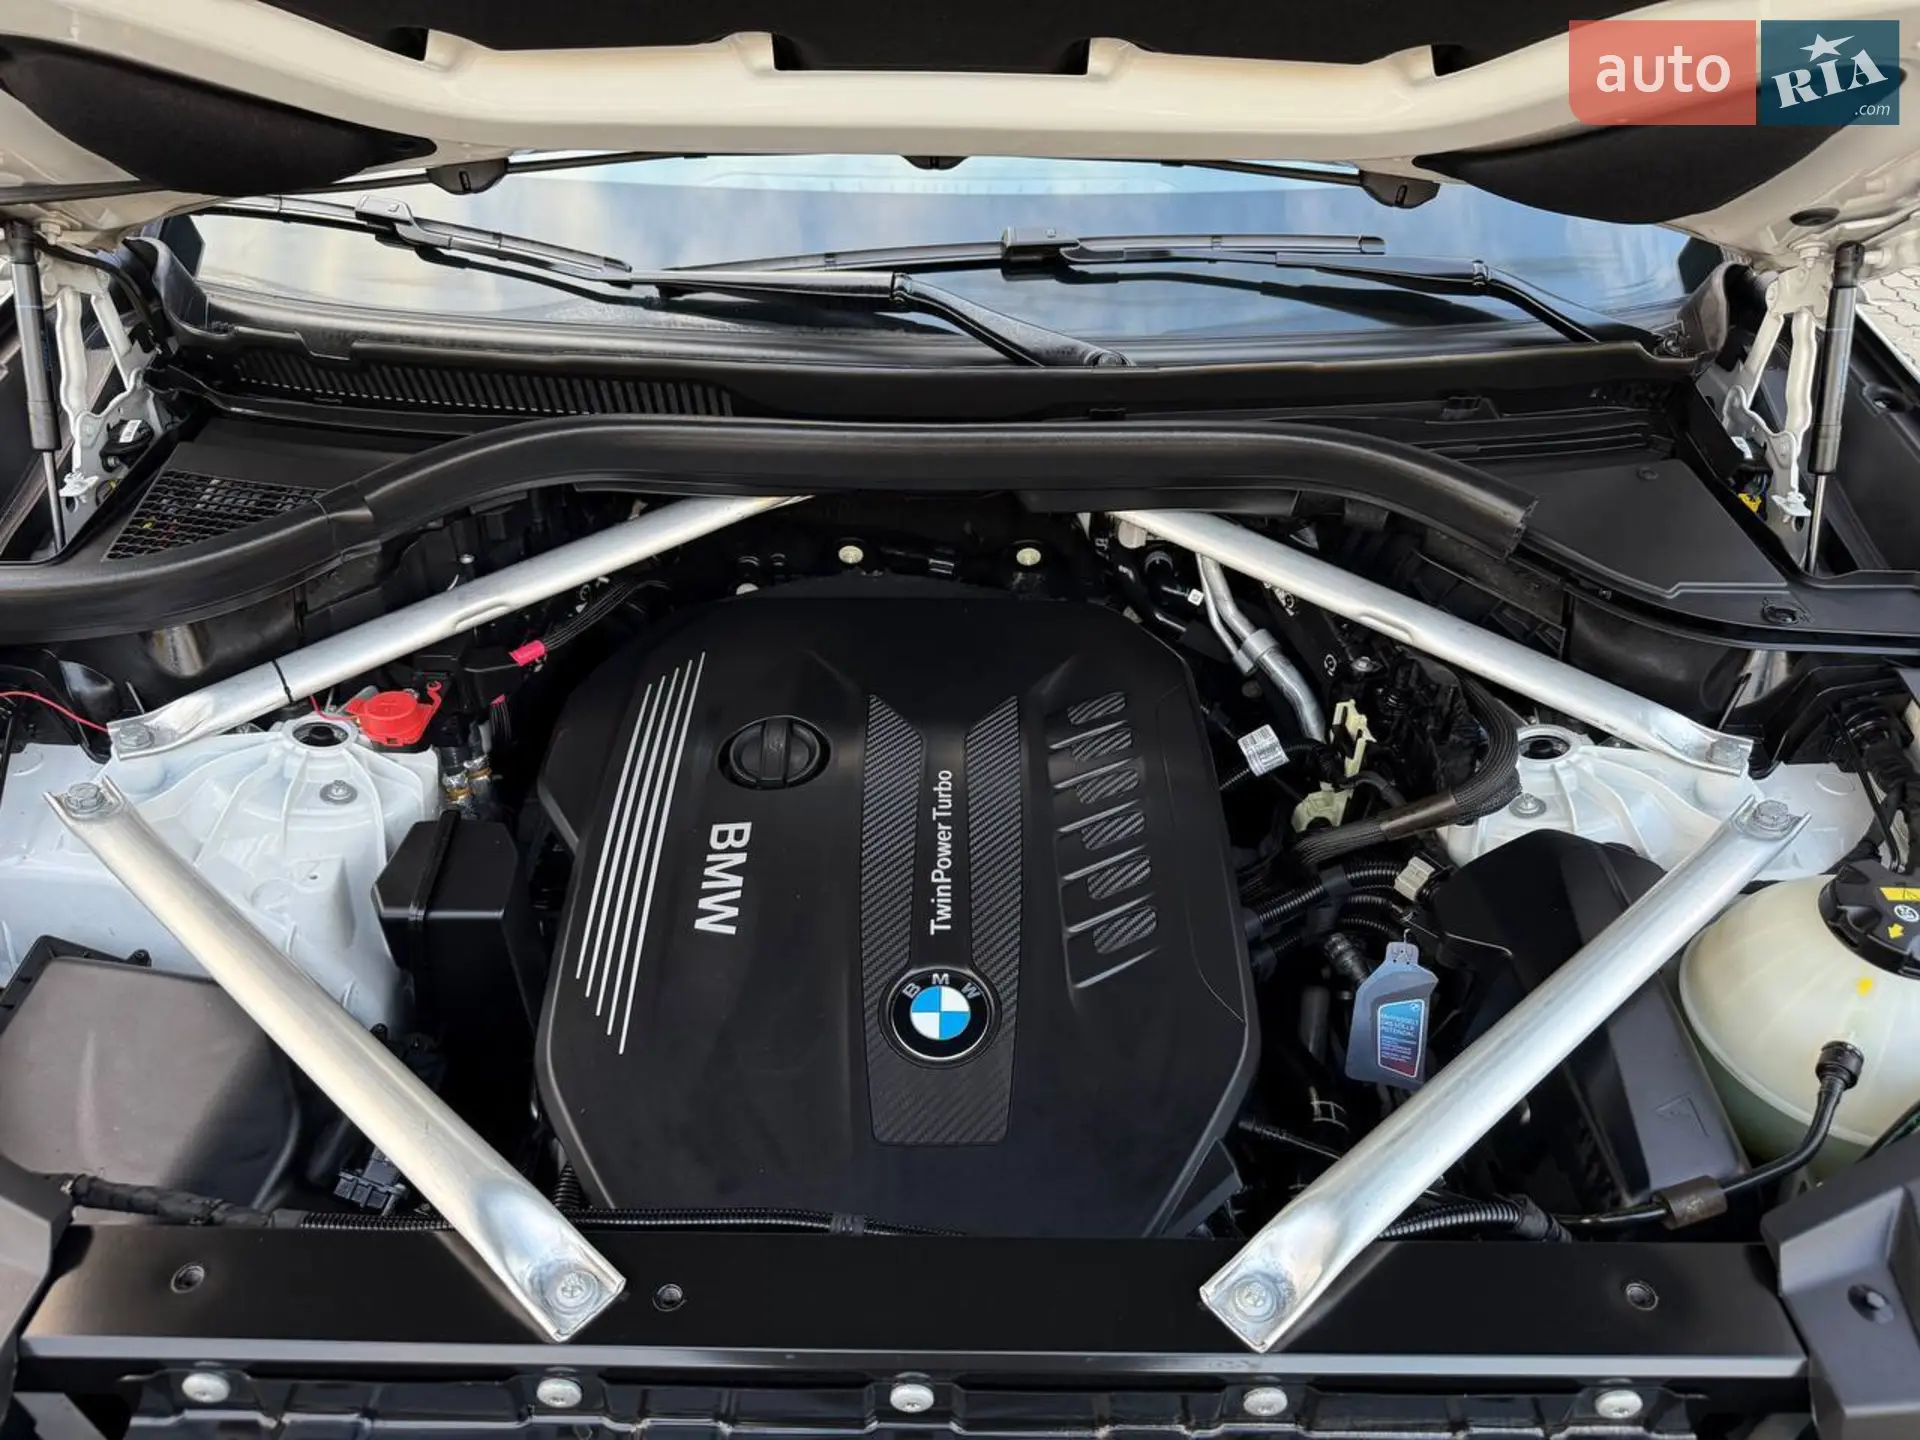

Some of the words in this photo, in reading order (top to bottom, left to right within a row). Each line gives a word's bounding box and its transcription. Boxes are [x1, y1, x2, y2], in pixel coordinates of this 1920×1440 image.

[932, 769, 952, 820] Turbo
[694, 821, 752, 935] BMW
[929, 822, 952, 935] TwinPower
[902, 972, 981, 1000] BMW
